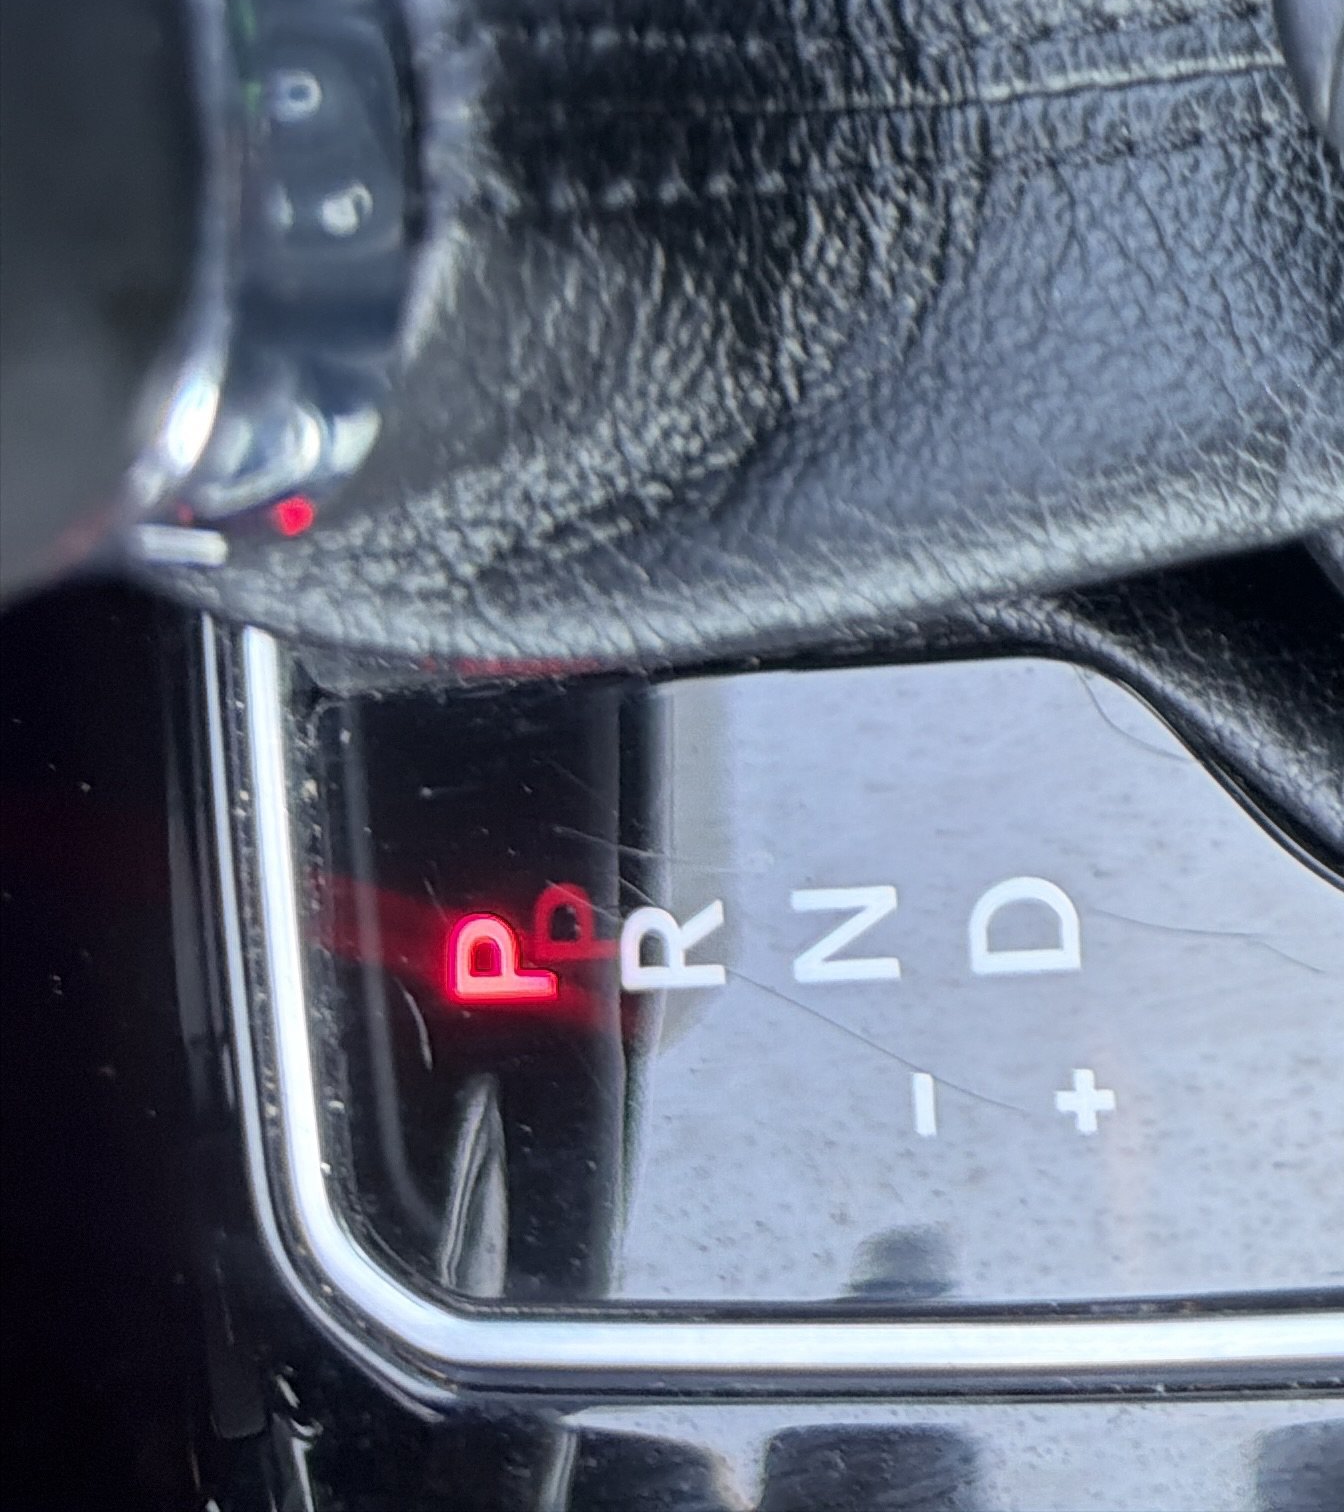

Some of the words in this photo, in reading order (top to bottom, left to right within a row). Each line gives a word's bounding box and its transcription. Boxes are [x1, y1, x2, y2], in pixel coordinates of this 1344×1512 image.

[449, 912, 558, 1004] P
[620, 898, 727, 990] R
[790, 885, 901, 982] N
[968, 876, 1082, 976] D
